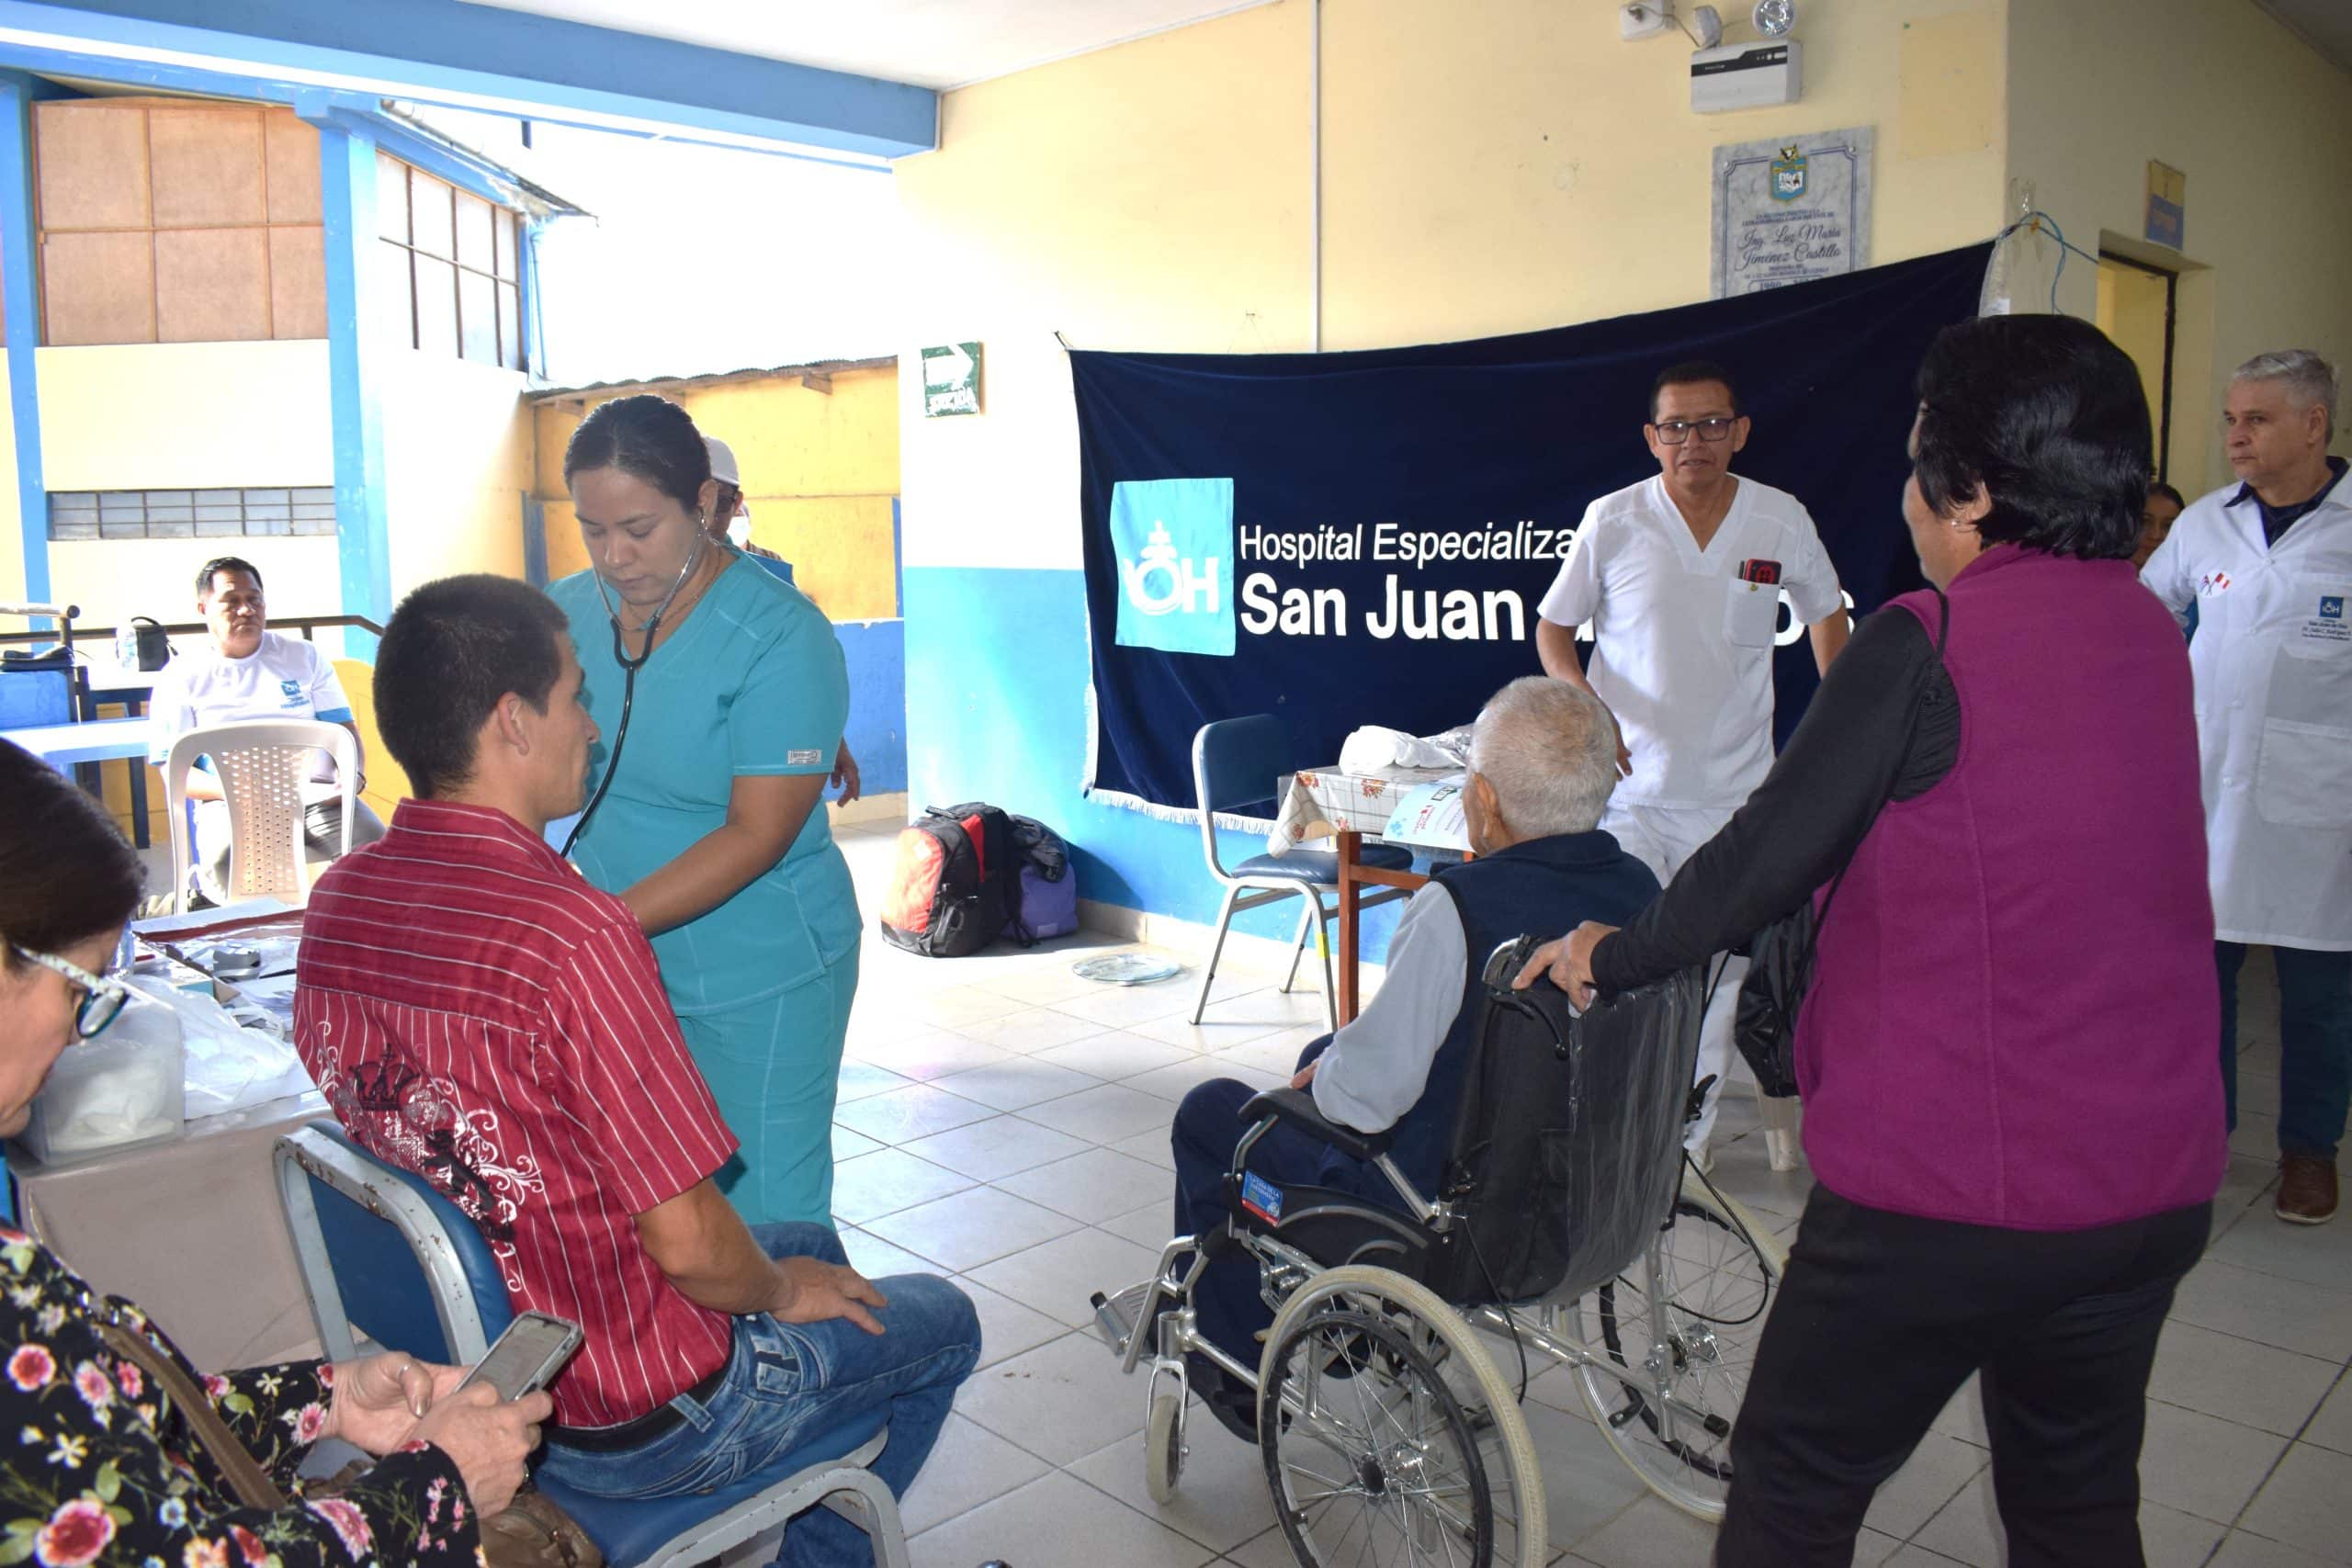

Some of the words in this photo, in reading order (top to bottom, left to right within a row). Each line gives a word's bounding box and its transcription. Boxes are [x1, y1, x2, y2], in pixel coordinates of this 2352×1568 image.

[1240, 523, 1363, 570] Hospital
[1373, 521, 1577, 570] Especializa
[1240, 572, 1347, 637] San
[1365, 573, 1525, 641] Juan
